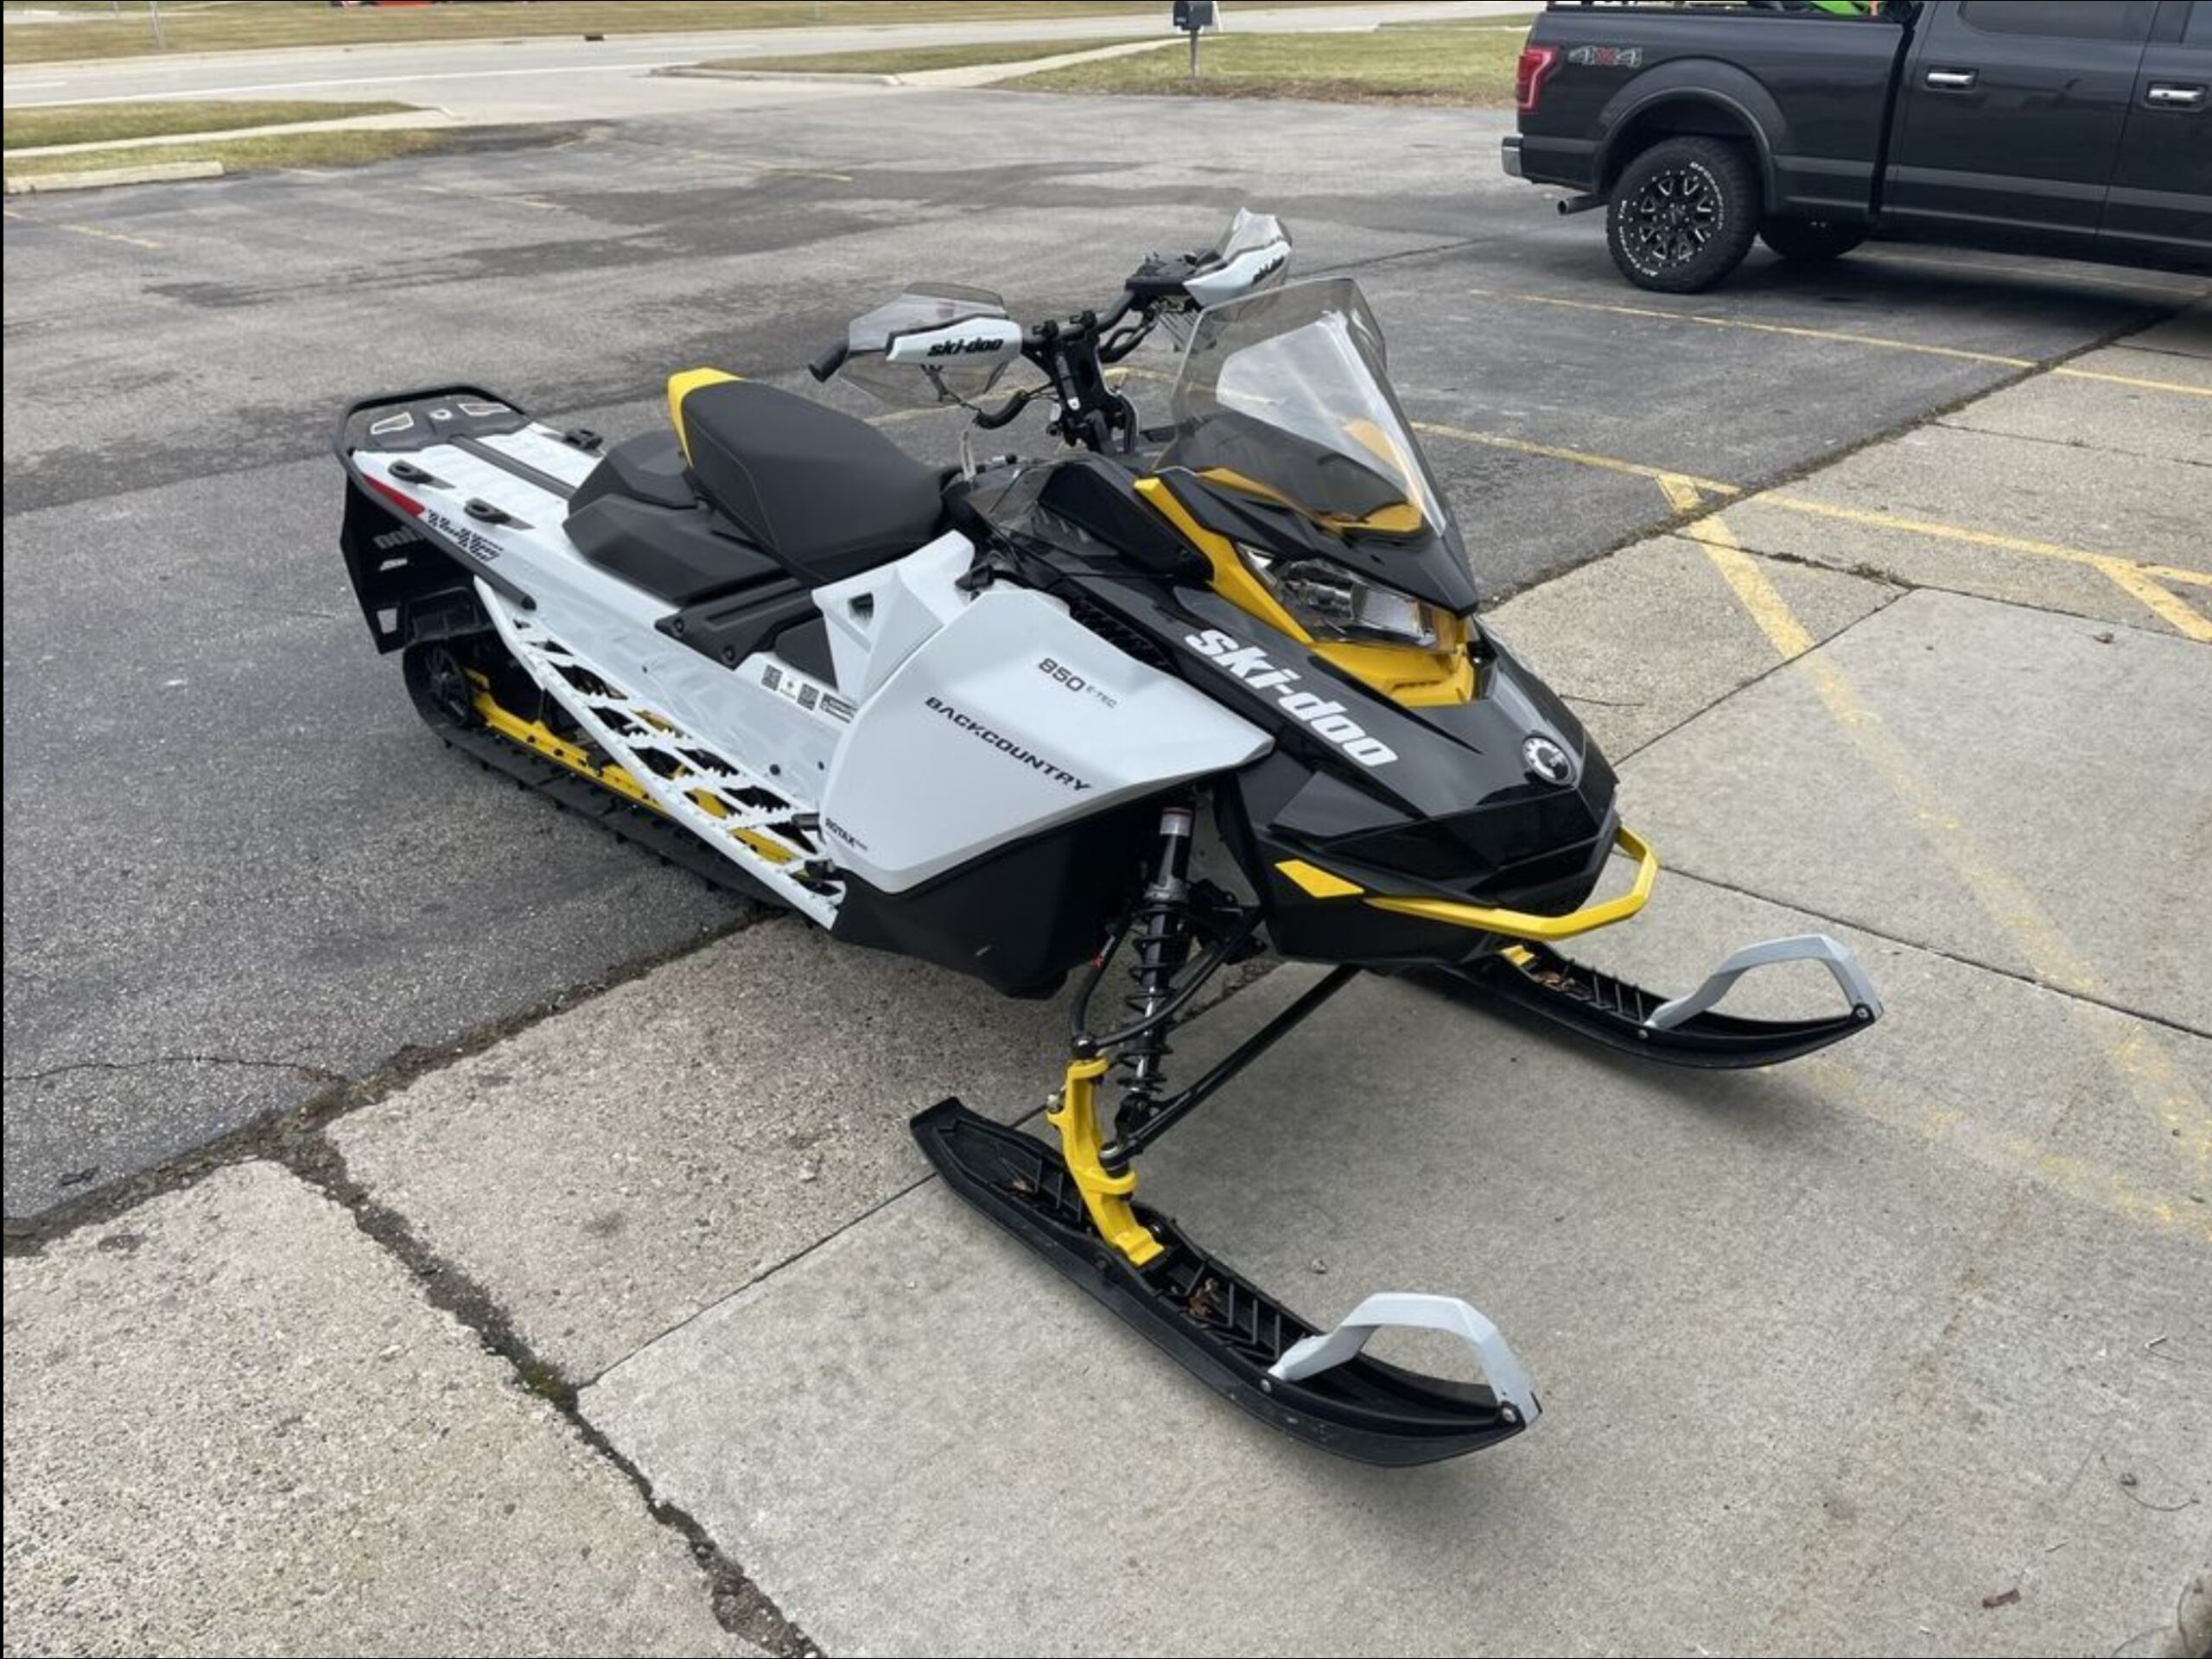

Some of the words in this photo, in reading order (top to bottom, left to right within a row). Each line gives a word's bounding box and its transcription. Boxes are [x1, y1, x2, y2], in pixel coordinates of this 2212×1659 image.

[927, 337, 1003, 356] ski-doo
[1039, 658, 1085, 692] 850
[1184, 629, 1398, 766] ski-doo
[925, 696, 1091, 791] BACKCOUNTRY
